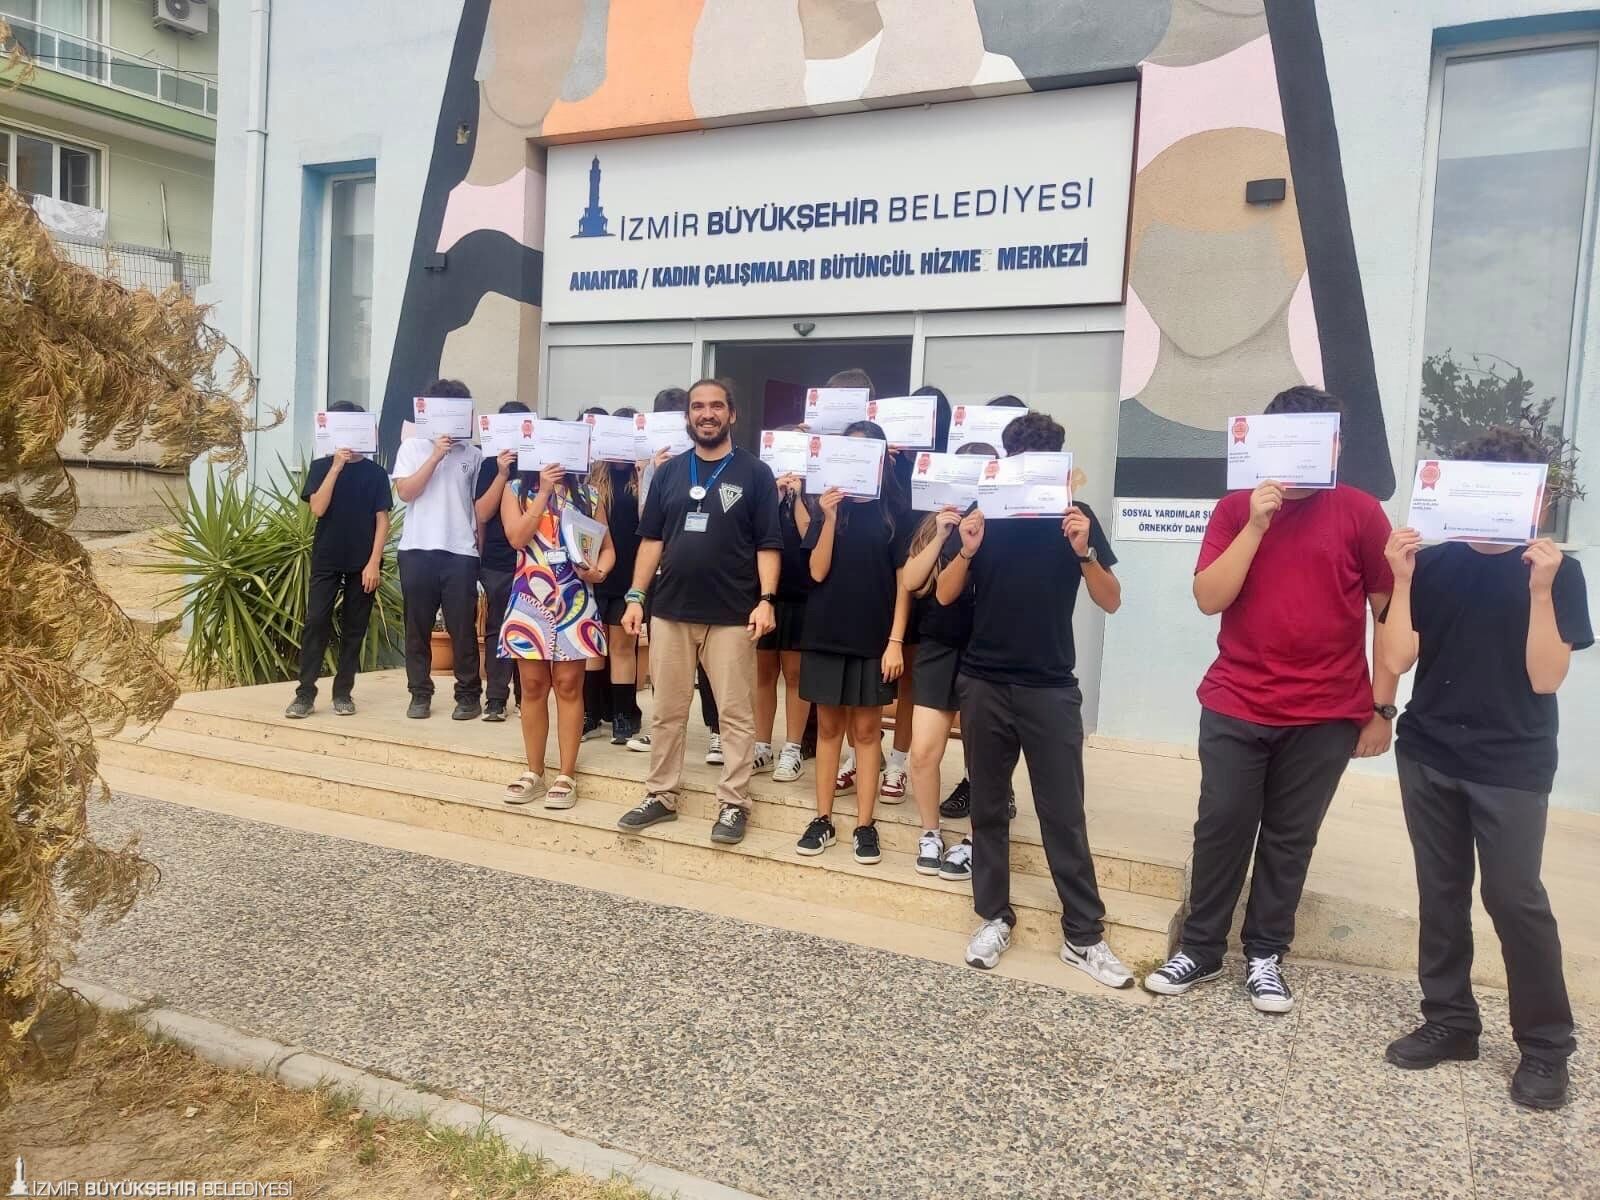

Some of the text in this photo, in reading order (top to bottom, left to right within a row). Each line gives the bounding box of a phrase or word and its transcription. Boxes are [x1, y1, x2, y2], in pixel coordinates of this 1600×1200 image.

[620, 177, 1094, 241] İZMİR BÜYÜKŞEHİR BELEDİYESİ
[569, 268, 638, 291] ANAHTAR
[652, 265, 700, 288] KADIN
[704, 258, 815, 288] ÇALIŞMALARI
[820, 249, 915, 280] BÜTÜNCÜL
[997, 237, 1088, 271] MERKEZİ
[1122, 508, 1152, 518] SOSYAL
[1154, 509, 1201, 519] YARDIMLAR
[1138, 522, 1182, 533] ÖRNEKKÖY
